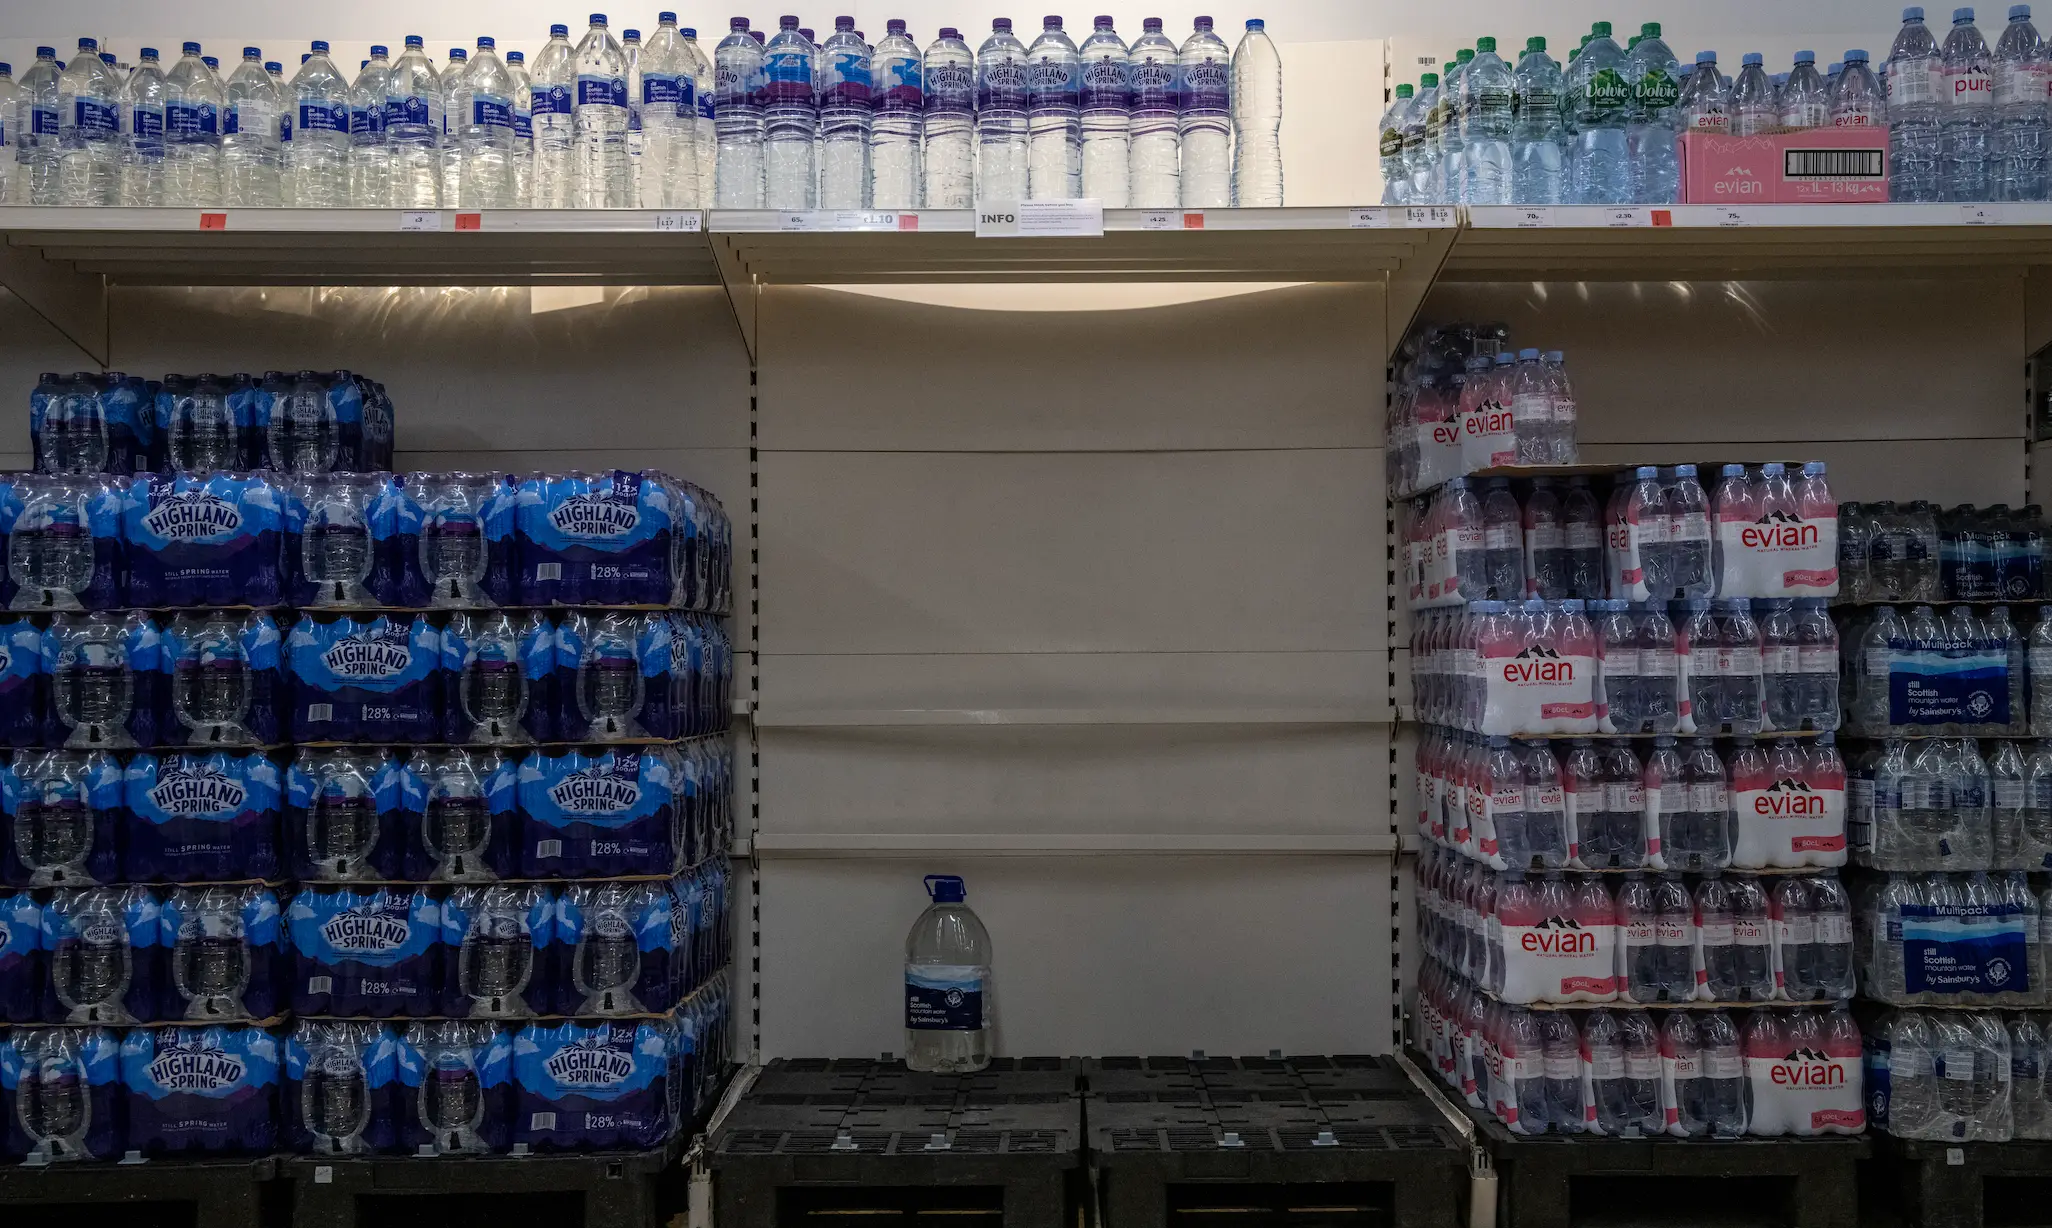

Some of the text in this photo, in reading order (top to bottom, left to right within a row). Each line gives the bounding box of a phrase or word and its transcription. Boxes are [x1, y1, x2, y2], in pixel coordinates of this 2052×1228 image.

[931, 71, 972, 87] HIGHLAND
[1085, 68, 1126, 83] HIGHLAND
[1130, 68, 1171, 84] HIGHLAND
[1187, 68, 1228, 84] HIGHLAND
[940, 81, 964, 89] SPRING
[1586, 82, 1628, 98] Volvic
[1636, 82, 1677, 97] Volvic
[1955, 79, 1992, 96] pure
[1699, 115, 1728, 126] evian
[1835, 115, 1868, 126] evian
[1715, 180, 1762, 194] evian
[1832, 183, 1844, 192] 13
[1846, 182, 1859, 194] kg
[864, 215, 893, 223] £1.10
[981, 214, 1015, 223] INFO
[1466, 412, 1513, 434] evian
[148, 506, 238, 534] HIGHLAND
[553, 506, 636, 529] HIGHLAND
[171, 523, 216, 537] SPRING
[573, 522, 615, 534] SPRING
[1742, 524, 1817, 548] evian
[596, 566, 620, 578] 28%
[1921, 640, 1973, 650] Multipack
[326, 646, 407, 669] HIGHLAND
[345, 663, 386, 675] SPRING
[1504, 659, 1572, 682] evian
[368, 707, 390, 719] 28%
[1908, 706, 1961, 716] by Sainsbury's
[154, 781, 243, 807] HIGHLAND
[554, 781, 636, 804] HIGHLAND
[574, 798, 615, 810] SPRING
[1493, 795, 1521, 805] evian
[1541, 794, 1562, 804] evia
[1755, 792, 1824, 815] evian
[174, 799, 220, 812] SPRING
[181, 844, 211, 852] SPRING
[597, 842, 620, 854] 28%
[1936, 906, 1988, 916] Multipack
[325, 920, 406, 944] HIGHLAND
[1656, 927, 1684, 938] evian
[1733, 926, 1761, 937] evian
[344, 936, 385, 949] SPRING
[1522, 930, 1594, 952] evian
[1926, 975, 1980, 985] by Sainsbury's
[367, 982, 389, 994] 28%
[918, 1016, 949, 1024] Sainsbury's
[611, 1028, 633, 1038] 12x
[150, 1056, 241, 1082] HIGHLAND
[549, 1053, 631, 1077] HIGHLAND
[568, 1070, 610, 1082] SPRING
[1771, 1062, 1844, 1085] evian
[170, 1075, 217, 1088] SPRING
[591, 1116, 614, 1128] 28%
